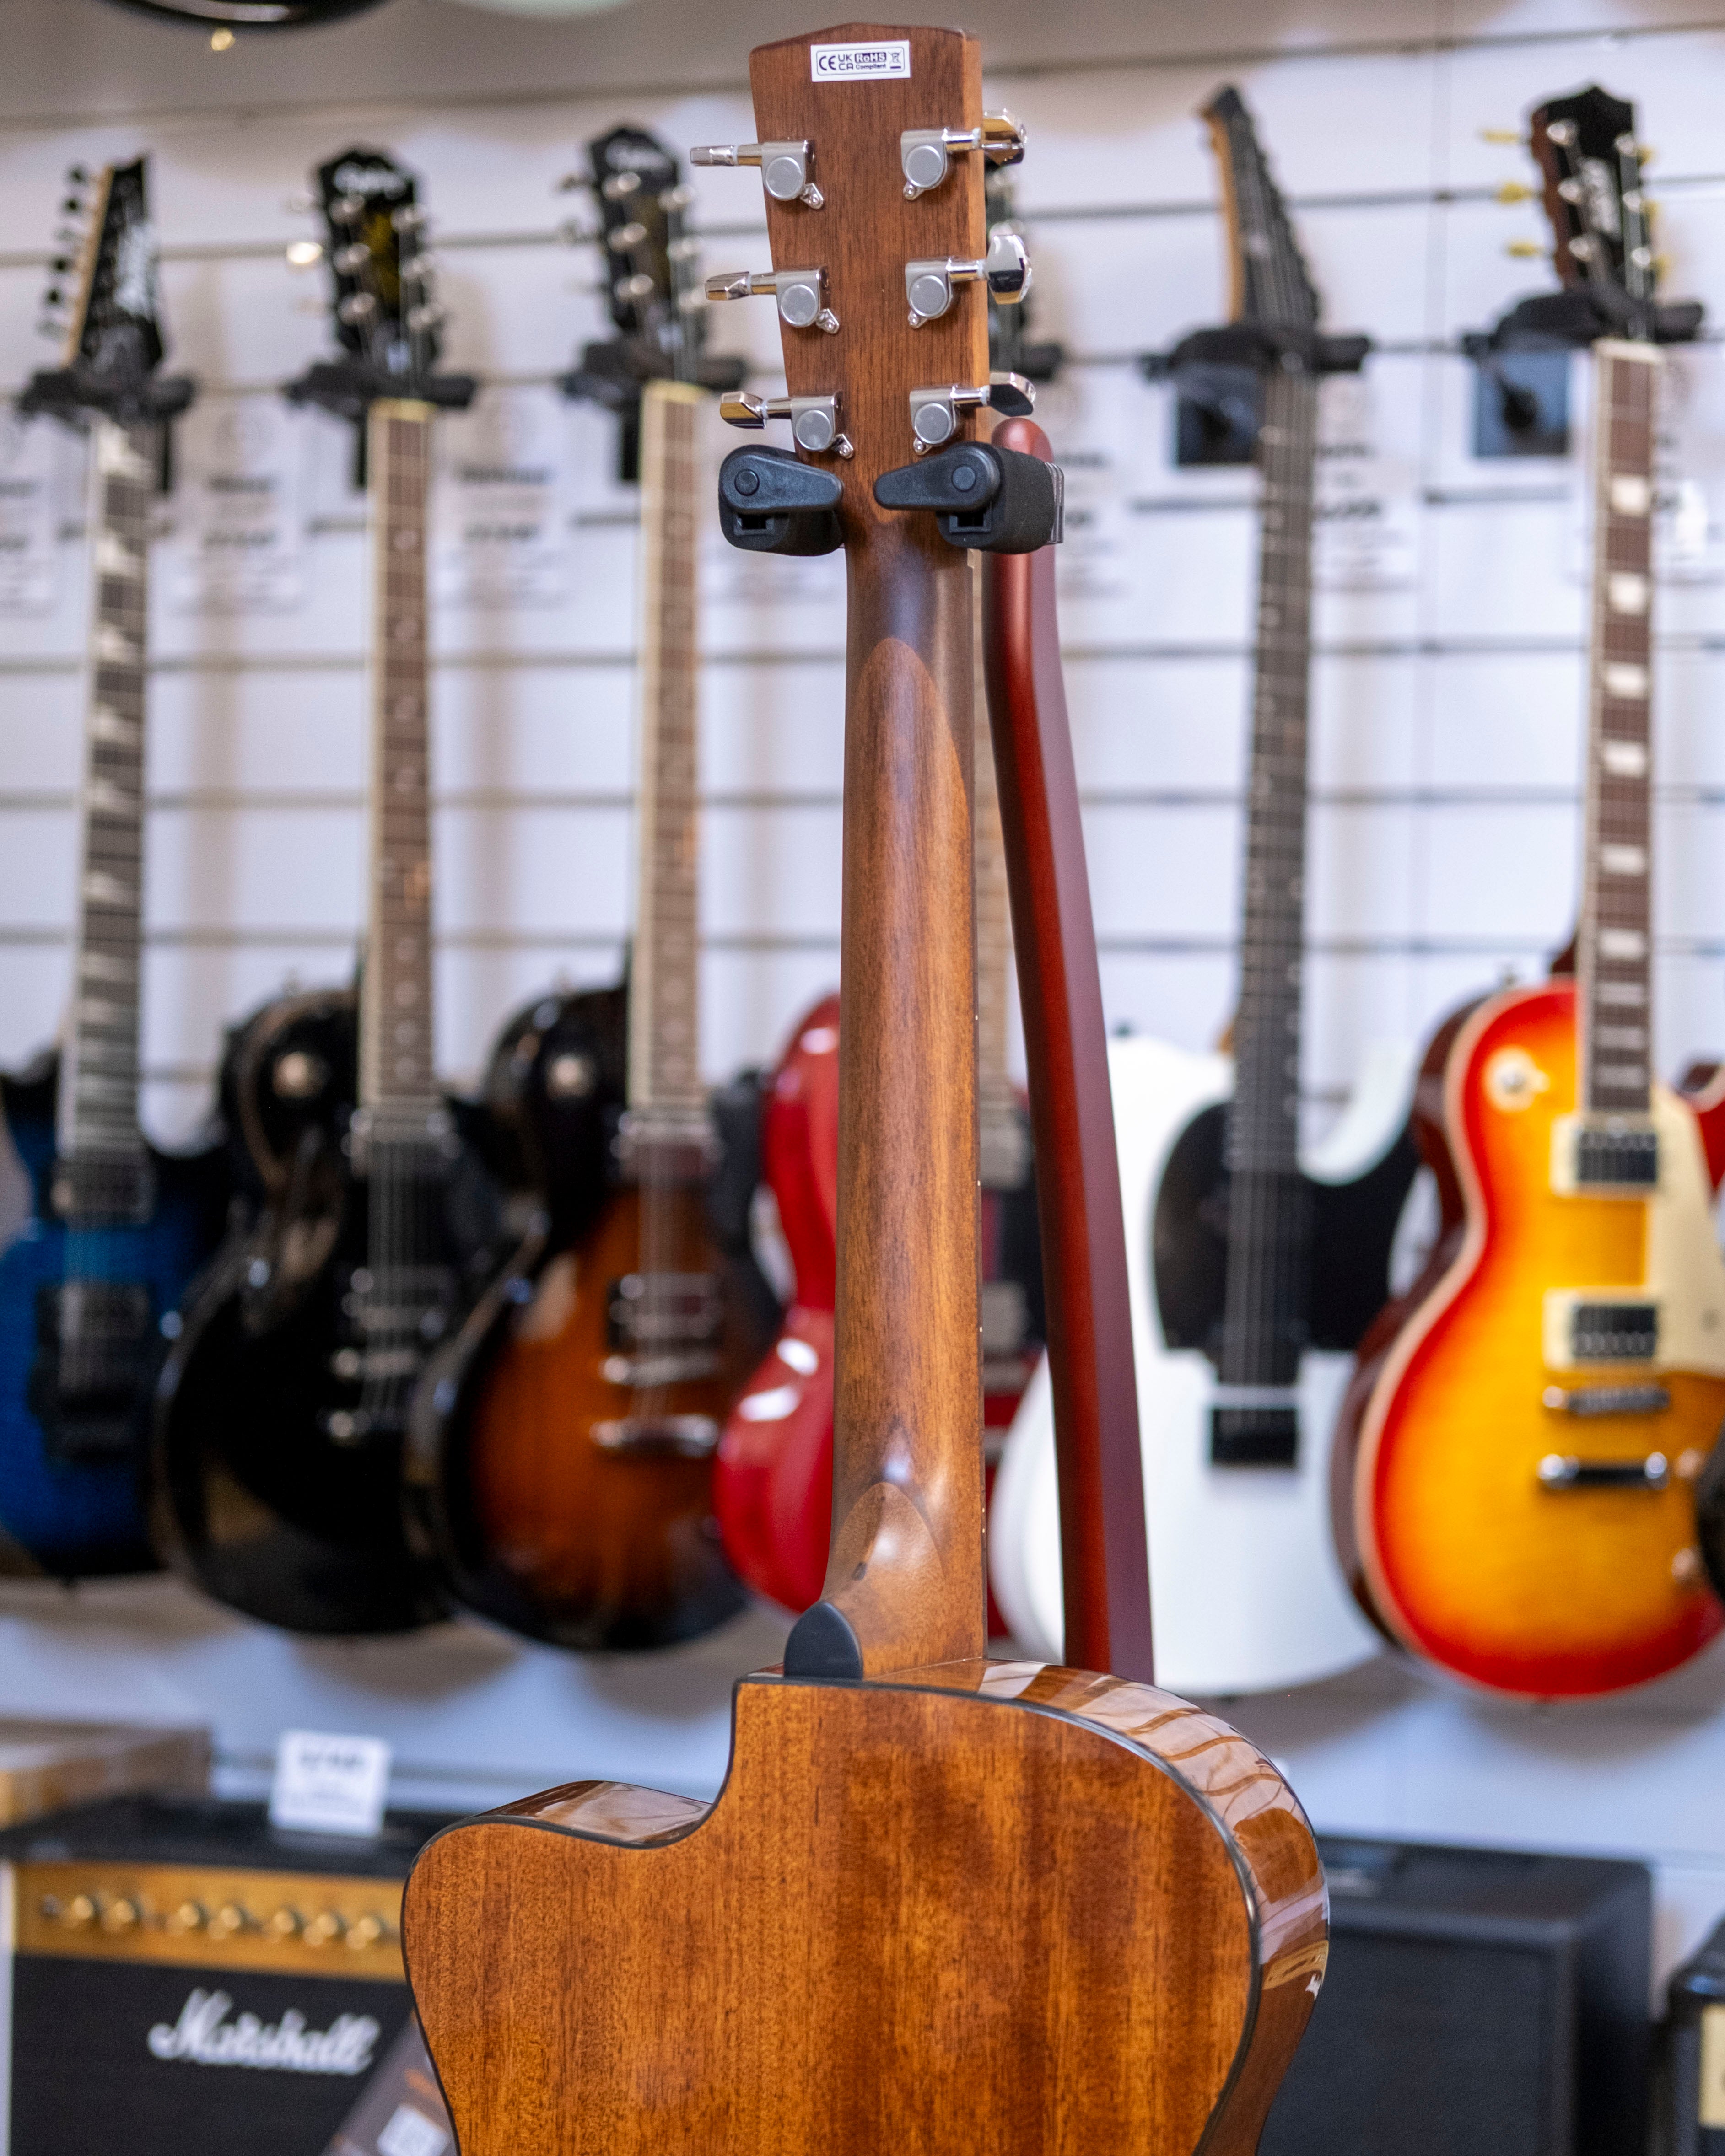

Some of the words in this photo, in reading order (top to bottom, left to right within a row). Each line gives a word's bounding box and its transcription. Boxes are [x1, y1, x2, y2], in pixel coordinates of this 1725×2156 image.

[819, 55, 836, 71] CE
[838, 54, 853, 62] UK
[856, 53, 886, 63] RoHS
[147, 1988, 380, 2074] Marshall
